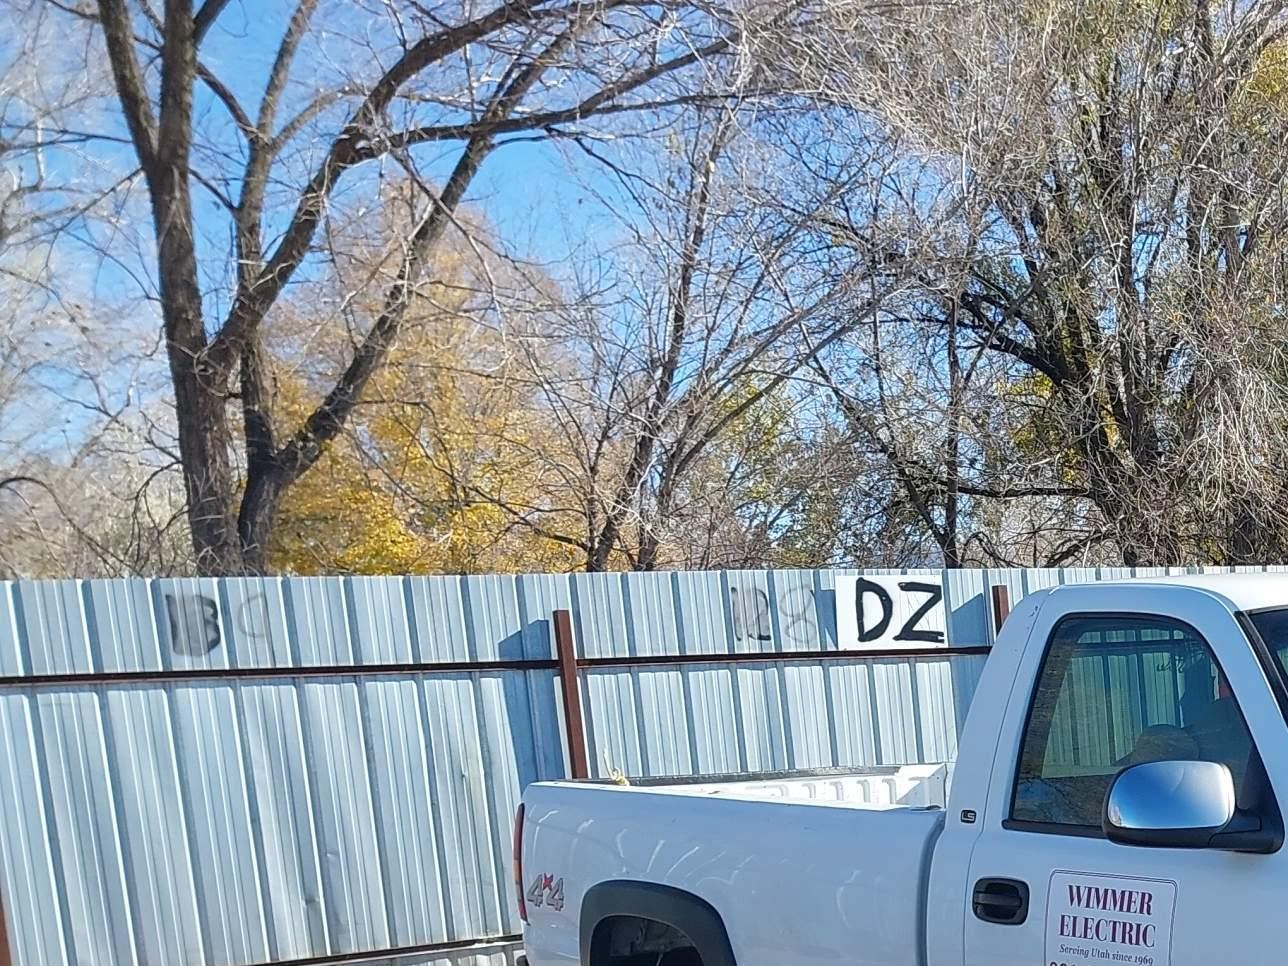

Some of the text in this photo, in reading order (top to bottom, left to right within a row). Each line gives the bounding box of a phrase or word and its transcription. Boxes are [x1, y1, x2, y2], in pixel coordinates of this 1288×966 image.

[856, 577, 945, 643] DZ
[961, 810, 976, 823] LS
[1067, 884, 1153, 916] WIMMER
[1059, 914, 1156, 948] ELECTRIC
[1059, 943, 1154, 966] Serving Utah since 1969
